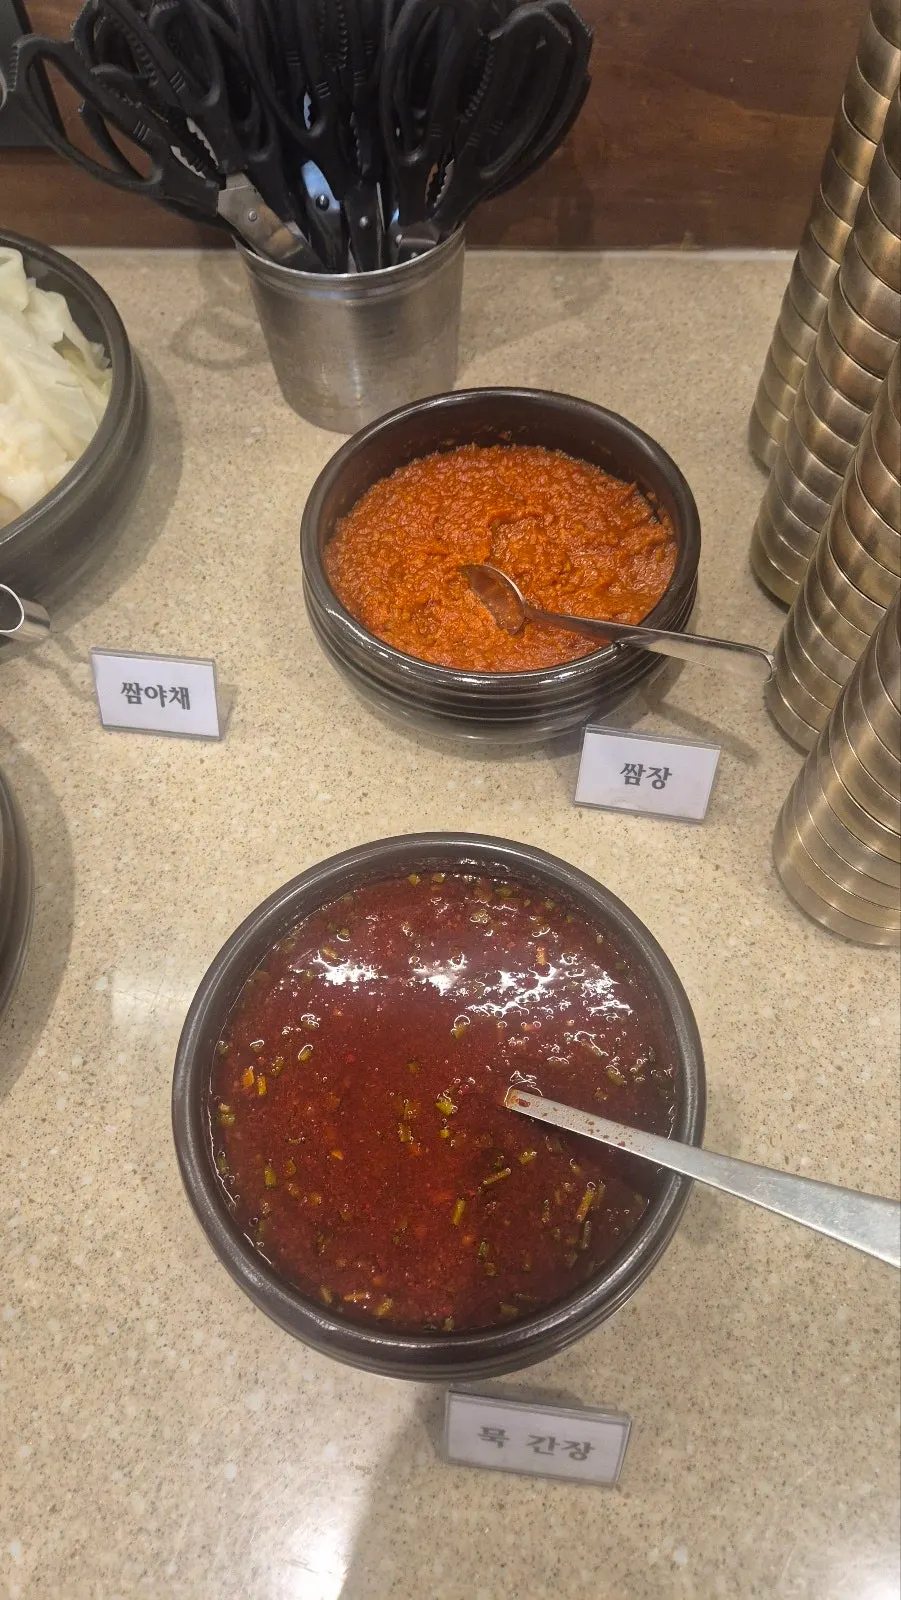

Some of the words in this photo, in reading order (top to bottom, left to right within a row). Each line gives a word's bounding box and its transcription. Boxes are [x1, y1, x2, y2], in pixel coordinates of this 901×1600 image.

[120, 681, 191, 711] 쌈야채
[619, 762, 673, 790] 쌈장
[526, 1434, 596, 1461] 간장
